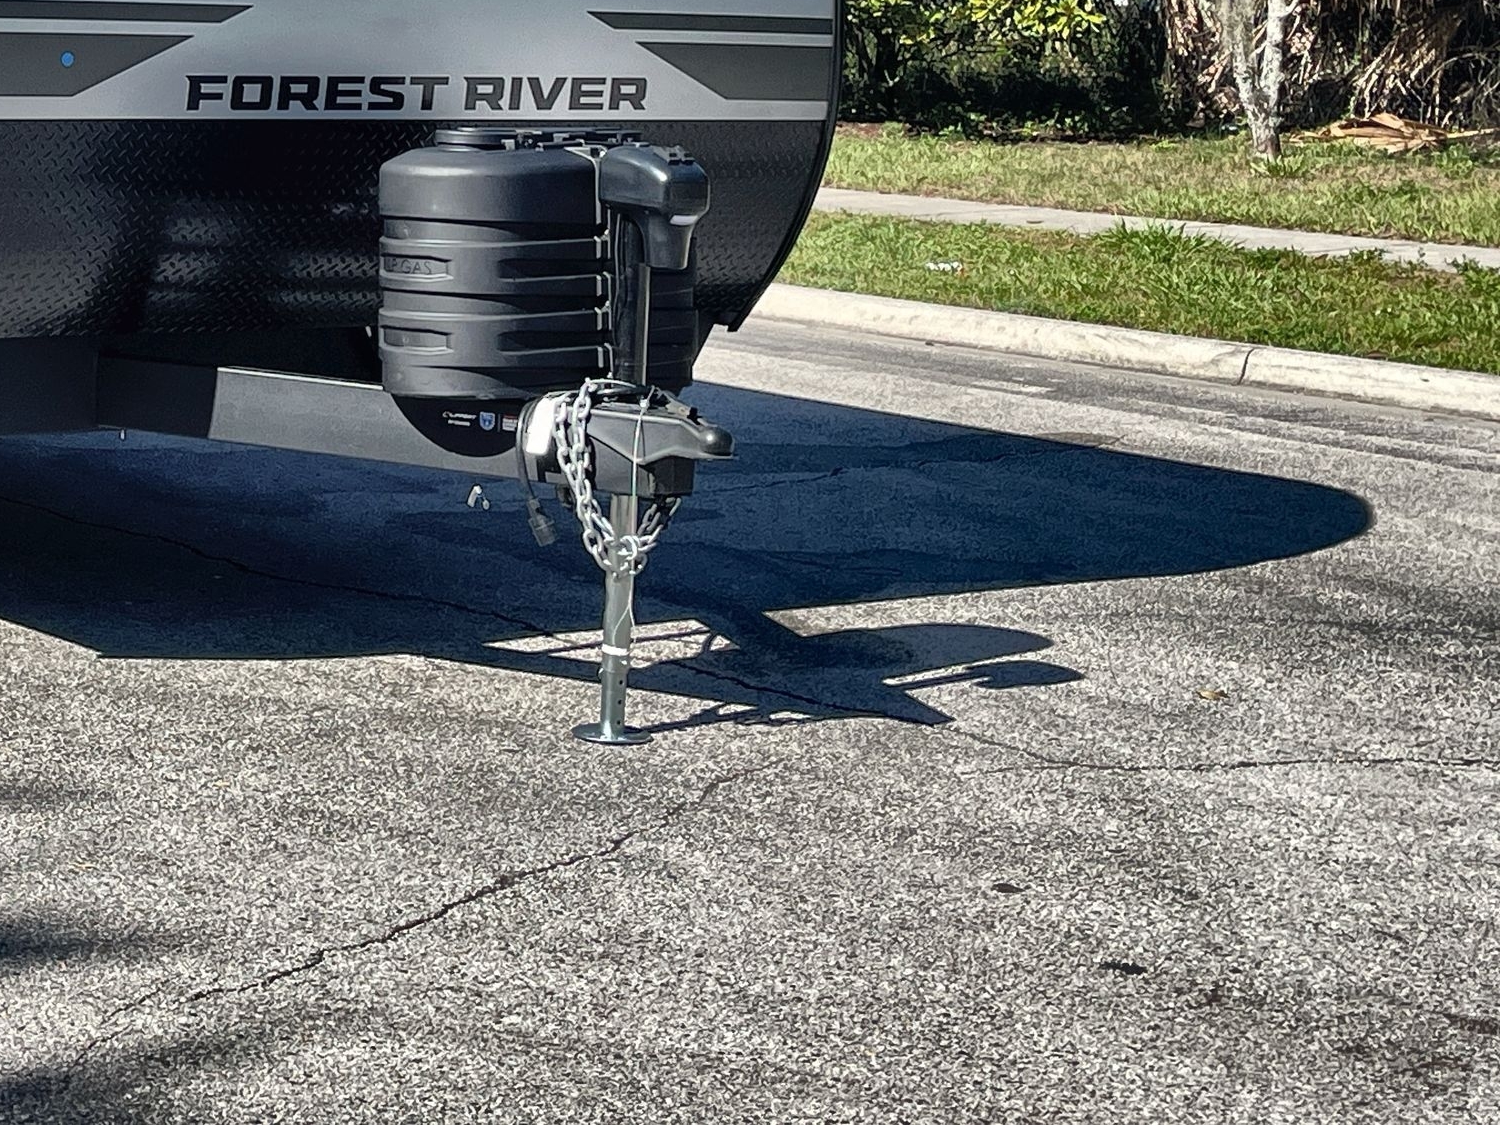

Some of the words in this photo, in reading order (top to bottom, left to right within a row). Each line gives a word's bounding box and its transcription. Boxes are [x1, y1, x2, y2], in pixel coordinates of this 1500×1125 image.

[185, 75, 450, 111] FOREST
[463, 76, 648, 111] RIVER
[401, 258, 433, 275] GAS
